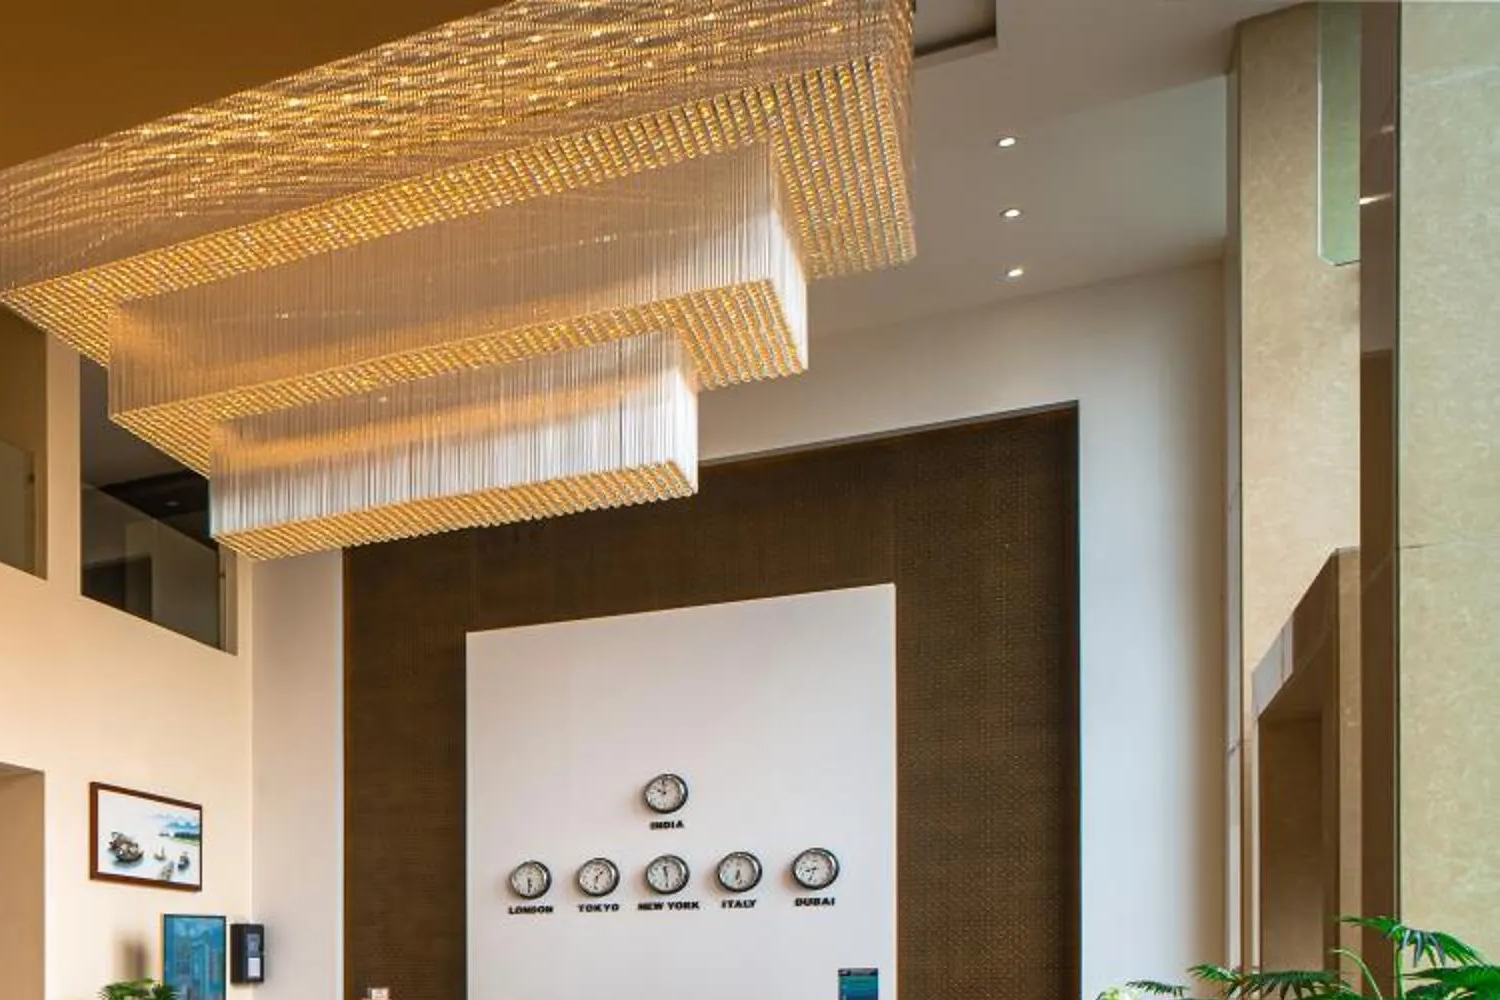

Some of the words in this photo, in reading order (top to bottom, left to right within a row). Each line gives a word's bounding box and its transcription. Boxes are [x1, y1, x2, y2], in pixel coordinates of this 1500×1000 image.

[649, 819, 685, 830] INDIA
[637, 901, 665, 911] NEW
[666, 901, 700, 911] YORK
[721, 899, 757, 909] ITALY
[794, 897, 836, 907] DUBAI
[507, 905, 554, 915] LONDON
[577, 903, 620, 913] TOKYO
